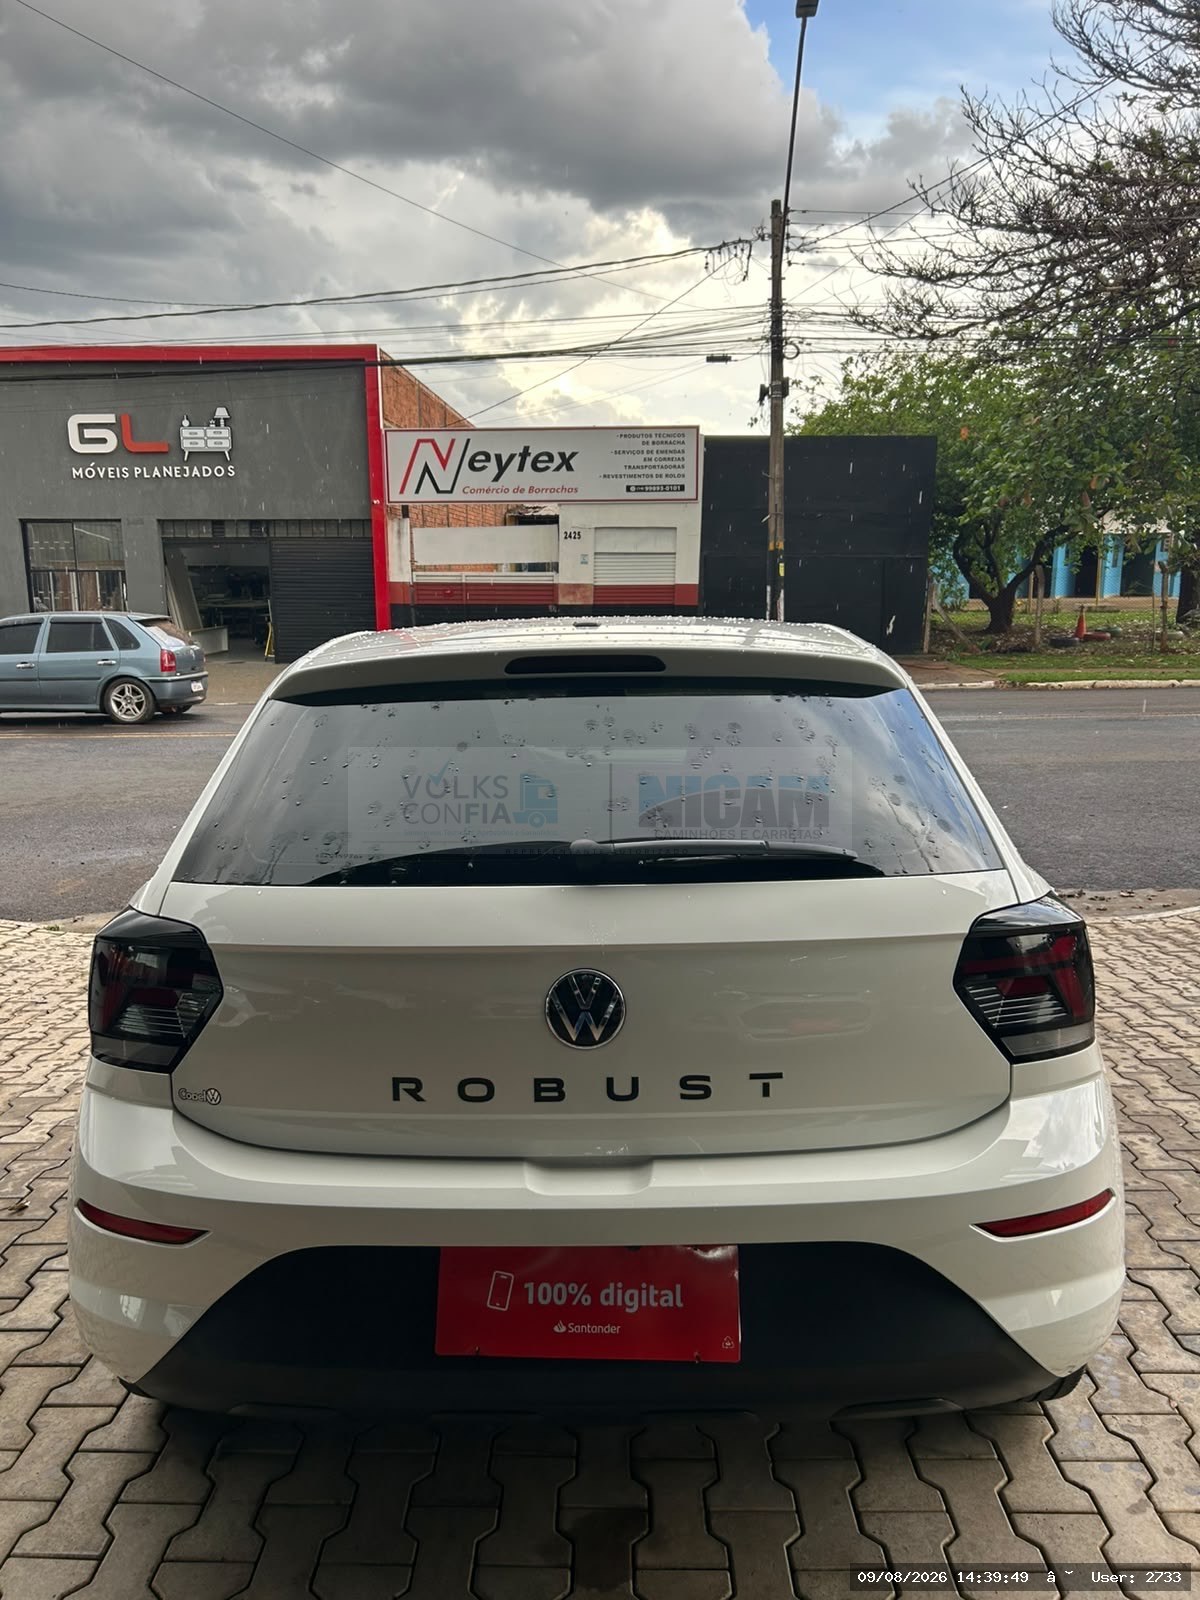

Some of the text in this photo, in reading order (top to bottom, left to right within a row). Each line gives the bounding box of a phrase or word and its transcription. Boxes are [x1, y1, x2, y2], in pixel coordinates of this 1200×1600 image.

[67, 413, 169, 454] GL
[72, 462, 236, 479] MÓVEIS PLANEJADOS
[399, 438, 579, 495] Neytex
[462, 485, 579, 495] Comércio de Borrachas
[563, 531, 582, 540] 2425
[391, 1072, 784, 1102] ROBUST
[523, 1282, 684, 1313] 100% digital
[567, 1321, 621, 1335] Santander
